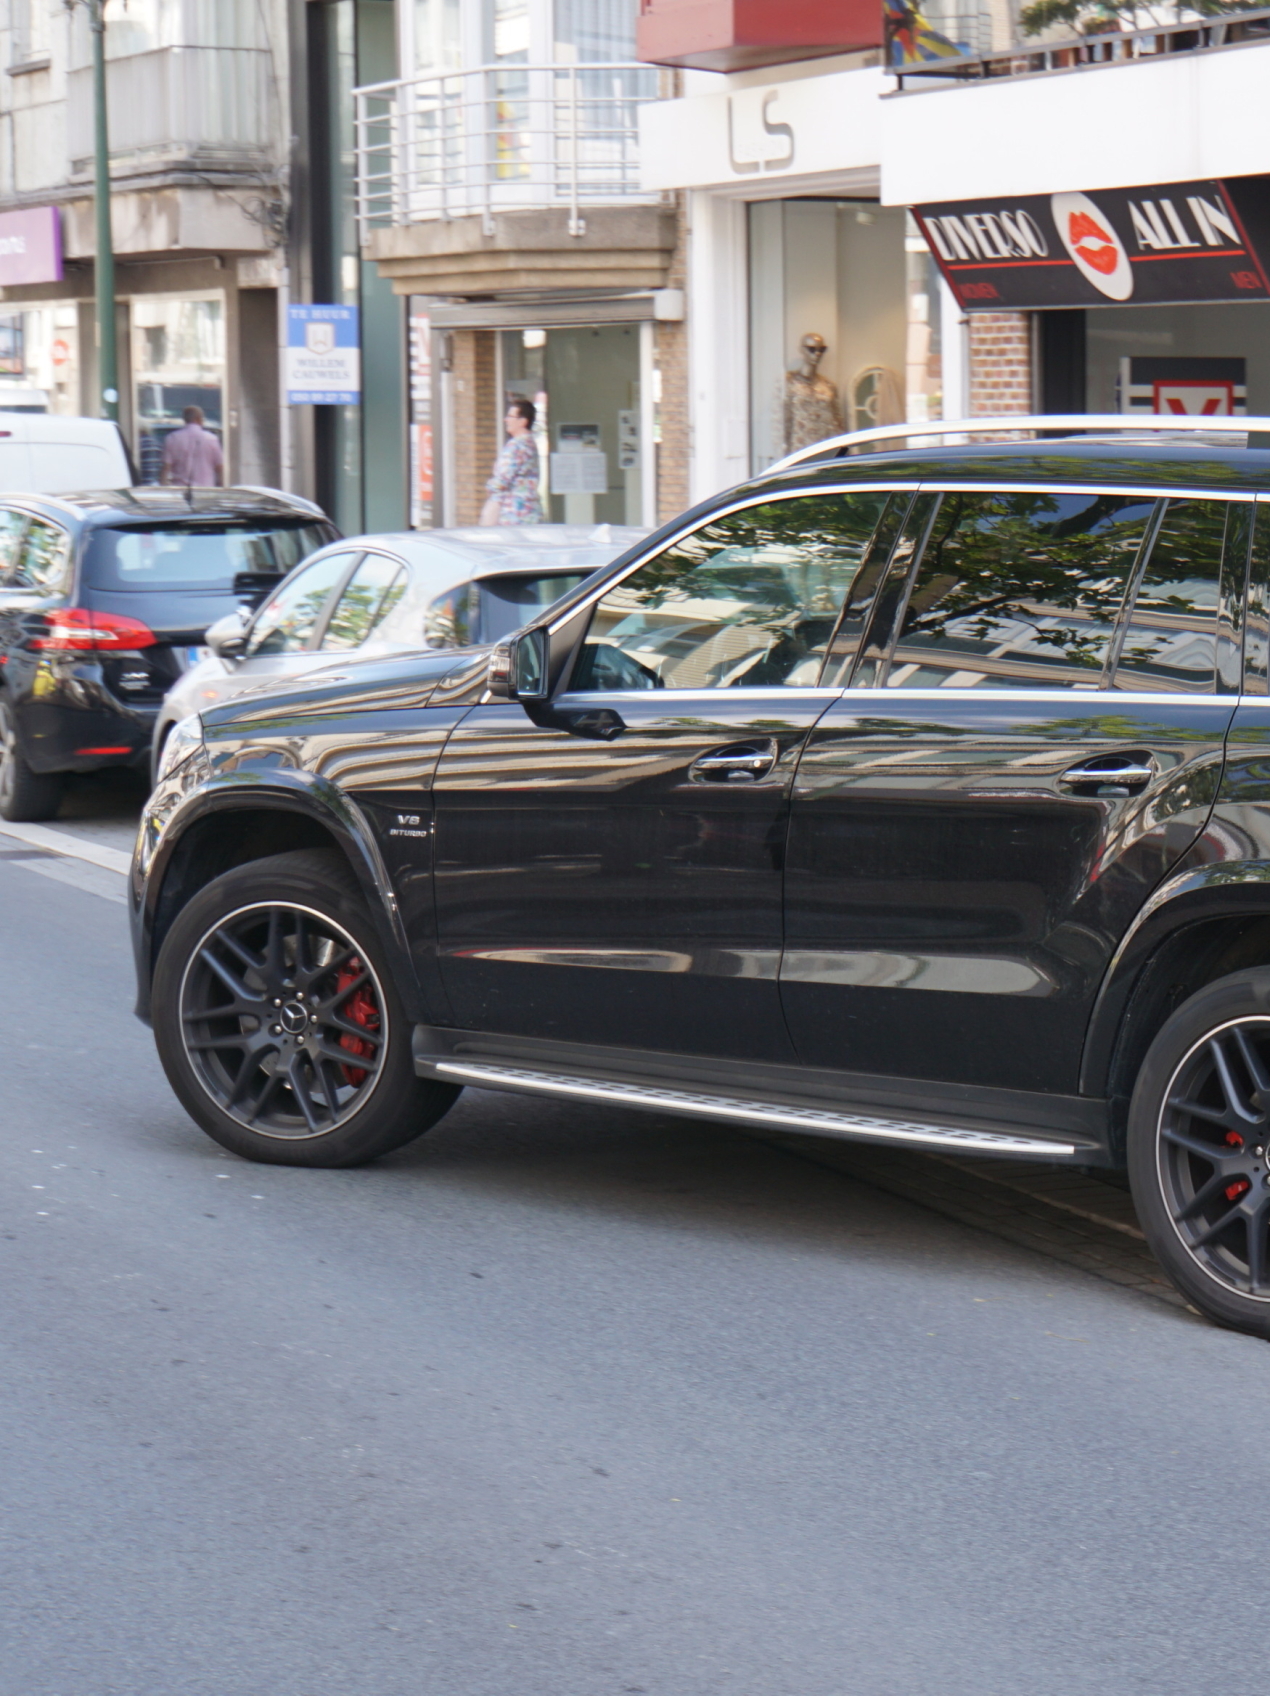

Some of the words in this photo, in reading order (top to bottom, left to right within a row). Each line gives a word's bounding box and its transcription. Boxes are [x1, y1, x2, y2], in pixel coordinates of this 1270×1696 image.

[727, 89, 795, 175] LS
[922, 209, 1049, 261] DIVERSO
[1128, 198, 1202, 250] ALL
[1186, 194, 1242, 247] IN
[1229, 271, 1263, 290] MEN
[398, 814, 420, 826] V8
[390, 828, 427, 838] BITURBO
